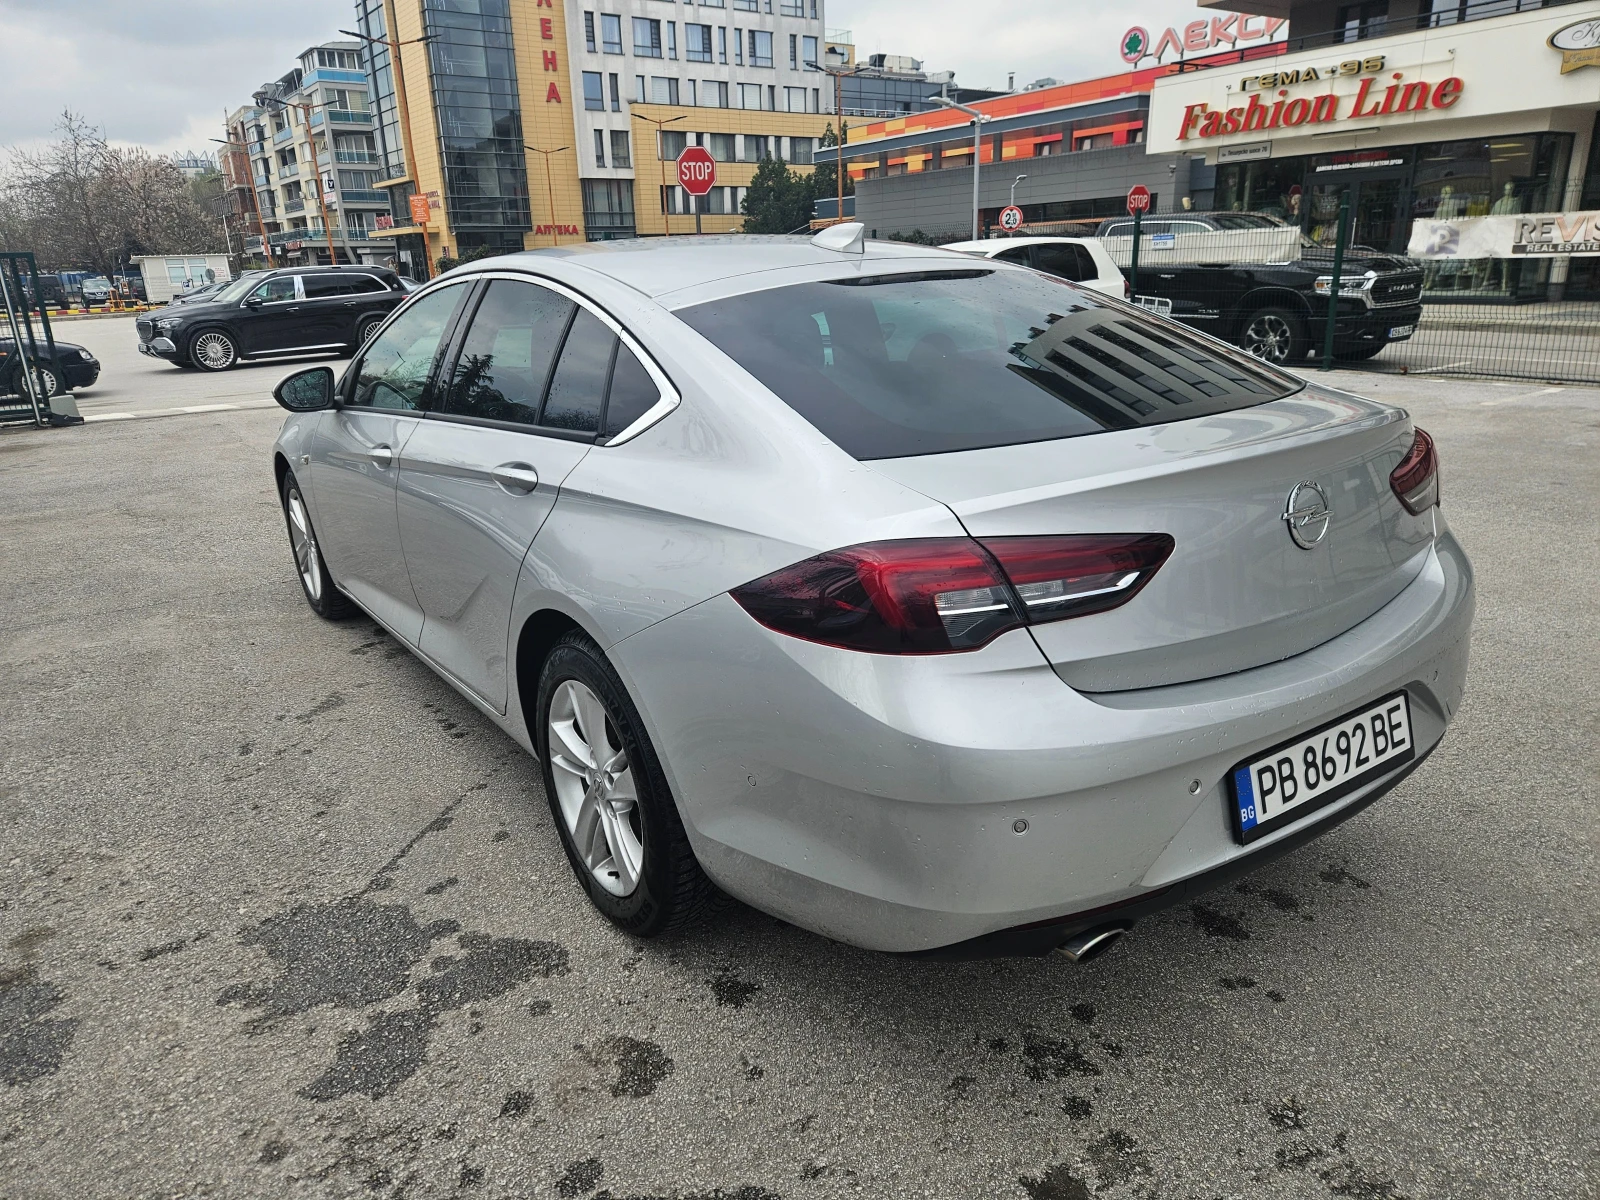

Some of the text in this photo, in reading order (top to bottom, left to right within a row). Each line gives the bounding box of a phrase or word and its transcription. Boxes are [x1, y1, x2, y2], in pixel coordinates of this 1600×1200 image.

[1176, 73, 1464, 140] Fashion Line
[681, 161, 712, 180] STOP
[1130, 194, 1149, 208] STOP
[535, 224, 579, 236] АПТЕКА
[1526, 243, 1600, 253] REAL ESTATE
[1257, 704, 1406, 814] PB 8692 BE
[1240, 805, 1255, 822] BG
